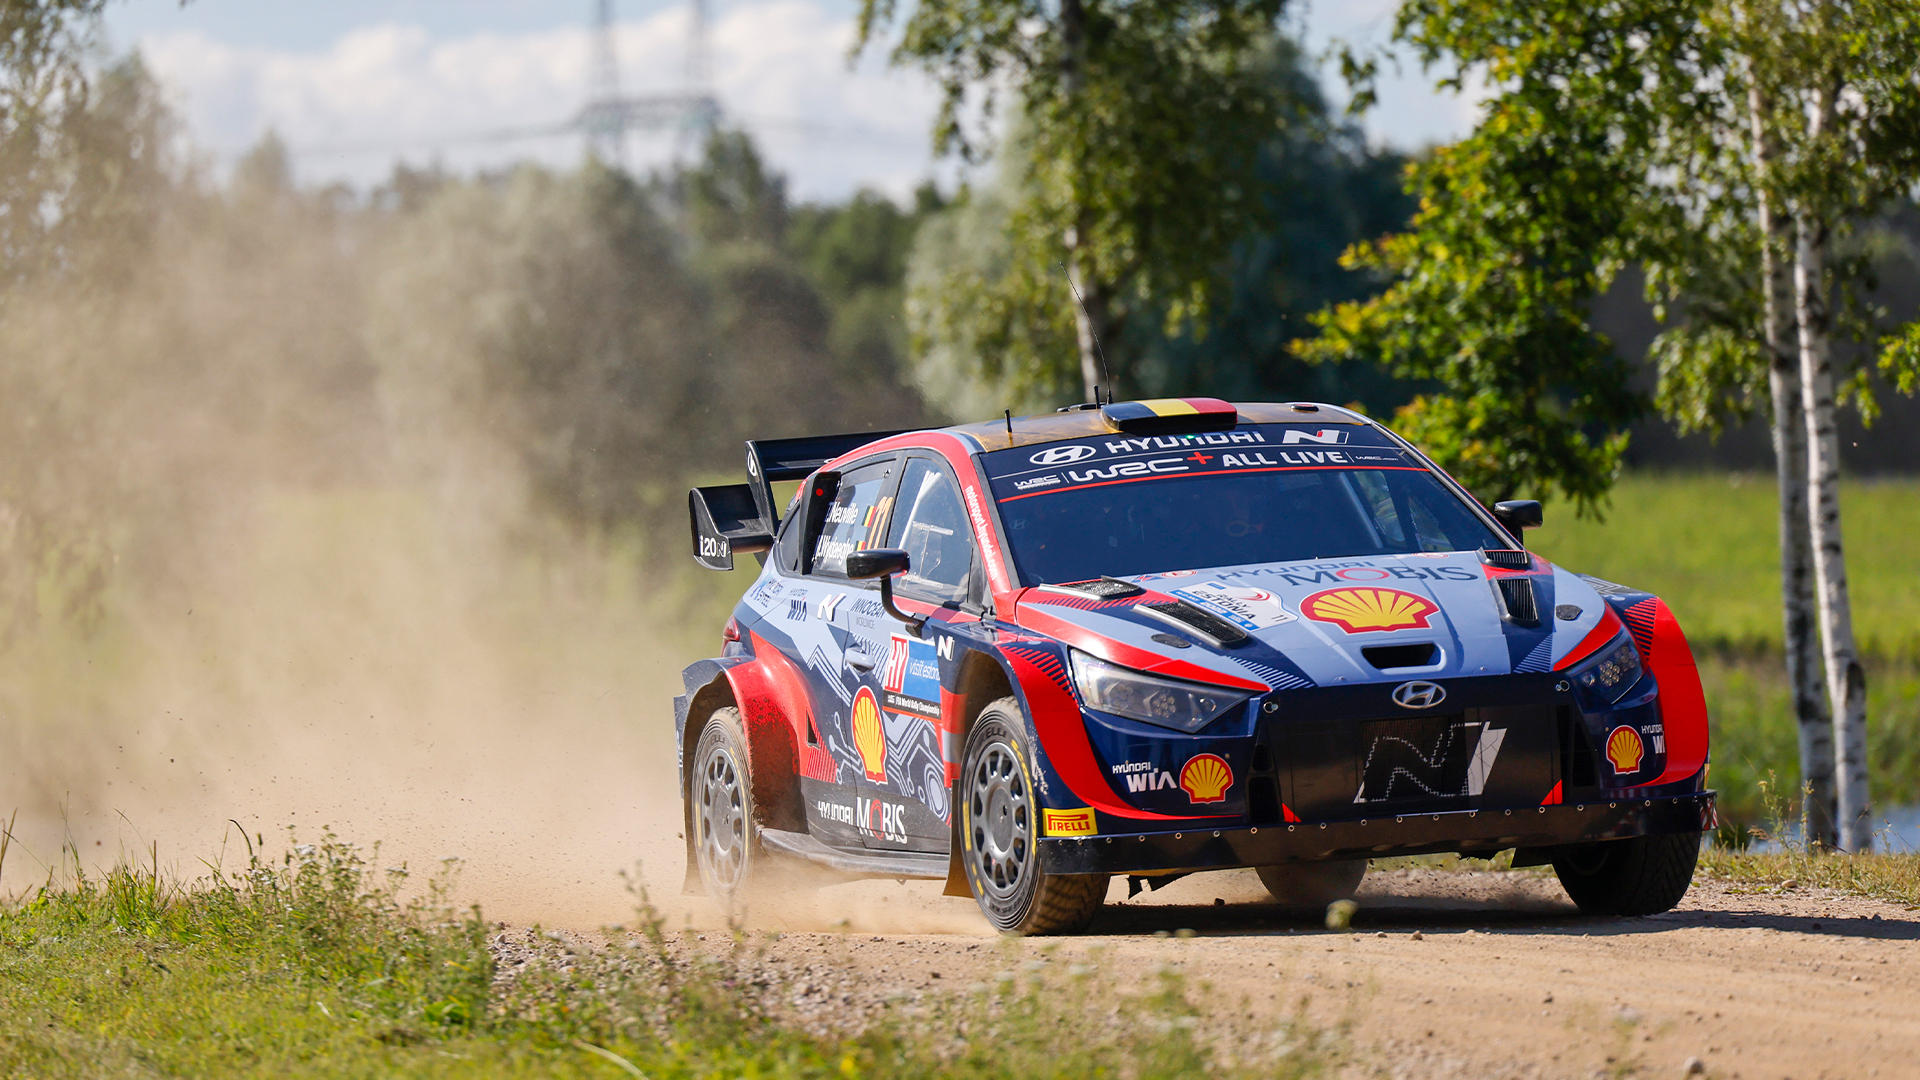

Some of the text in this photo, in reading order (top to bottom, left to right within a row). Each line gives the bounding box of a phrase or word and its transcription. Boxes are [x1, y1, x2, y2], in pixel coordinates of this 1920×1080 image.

[1104, 431, 1265, 454] HYUNDAI
[1222, 453, 1278, 467] ALL
[1280, 451, 1348, 464] LIVE
[867, 496, 894, 549] 11
[965, 484, 998, 581] motorsport.hyundai.com
[1216, 561, 1376, 581] HYUNDAI
[1280, 566, 1479, 586] MOBIS
[787, 599, 807, 622] WIA
[850, 598, 887, 619] INNOCEAN
[1192, 590, 1256, 619] ESTONIA
[1217, 593, 1252, 608] RALLY
[1271, 614, 1289, 622] 11
[1641, 724, 1664, 735] HYUNDA
[1112, 761, 1152, 774] HYUNDAI
[1126, 767, 1177, 793] WIA
[818, 796, 908, 844] HYUNDAI MOBIS
[1047, 813, 1090, 831] PIRELLI
